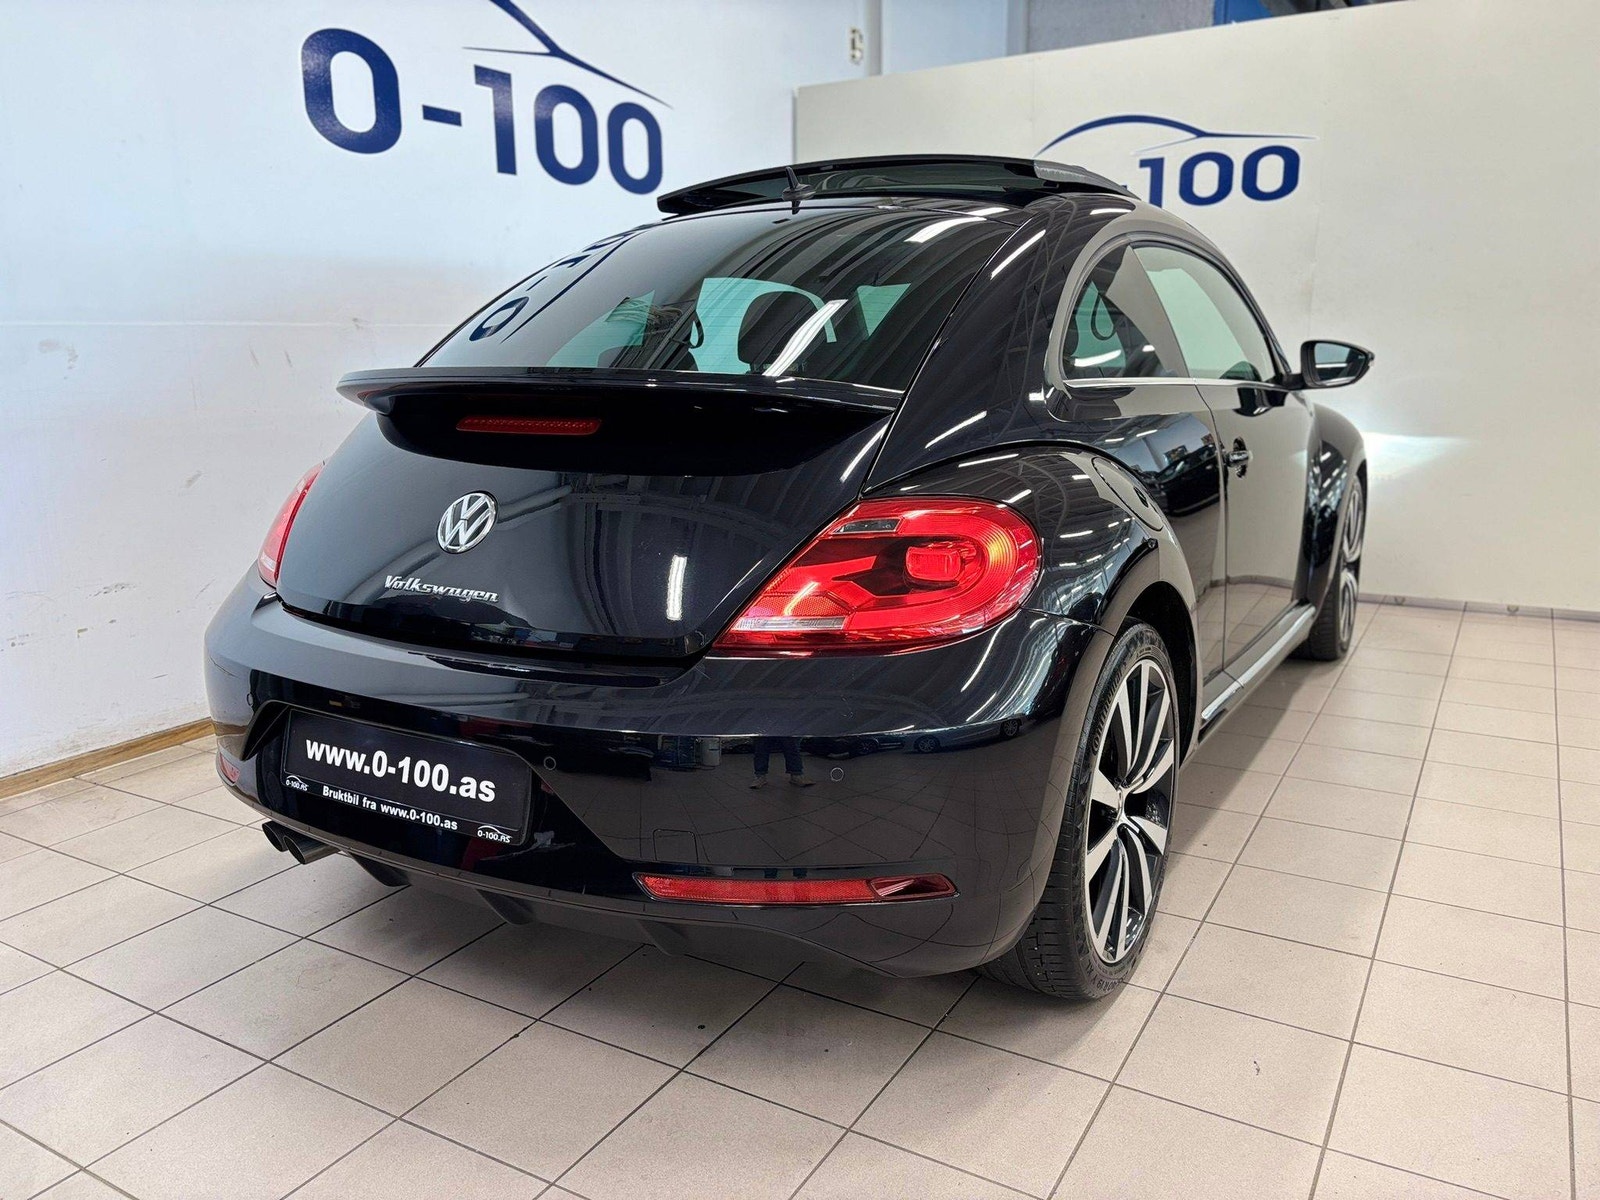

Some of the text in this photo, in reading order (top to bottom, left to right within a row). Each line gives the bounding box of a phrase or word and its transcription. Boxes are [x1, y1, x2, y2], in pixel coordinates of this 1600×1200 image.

[301, 27, 663, 195] 0-100
[1122, 144, 1301, 209] 100
[384, 575, 499, 602] Volkswagen
[305, 739, 496, 802] www.0-100.as
[322, 785, 458, 831] Bruktbil fra www.0-100.as
